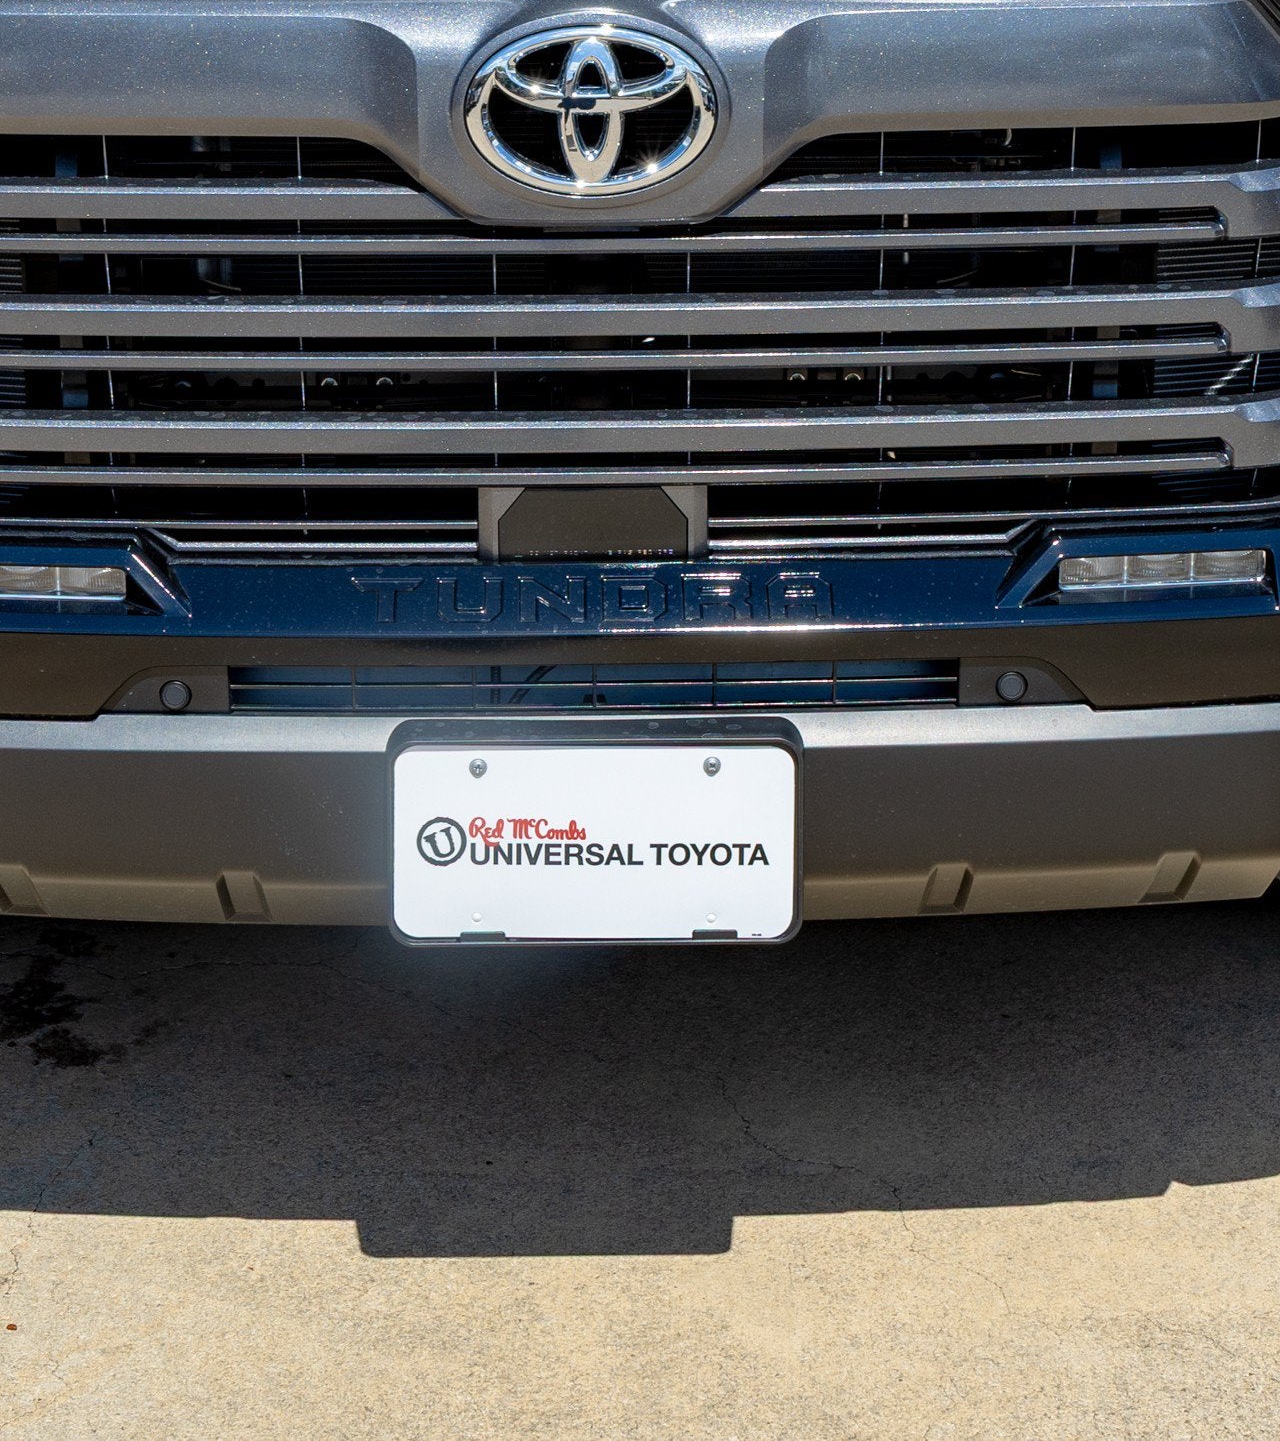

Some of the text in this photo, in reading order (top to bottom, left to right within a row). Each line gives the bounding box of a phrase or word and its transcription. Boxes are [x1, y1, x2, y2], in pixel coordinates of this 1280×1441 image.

[351, 571, 834, 623] TUNDRA
[469, 816, 587, 847] Red McCombs
[470, 843, 769, 866] UNIVERSAL TOYOTA
